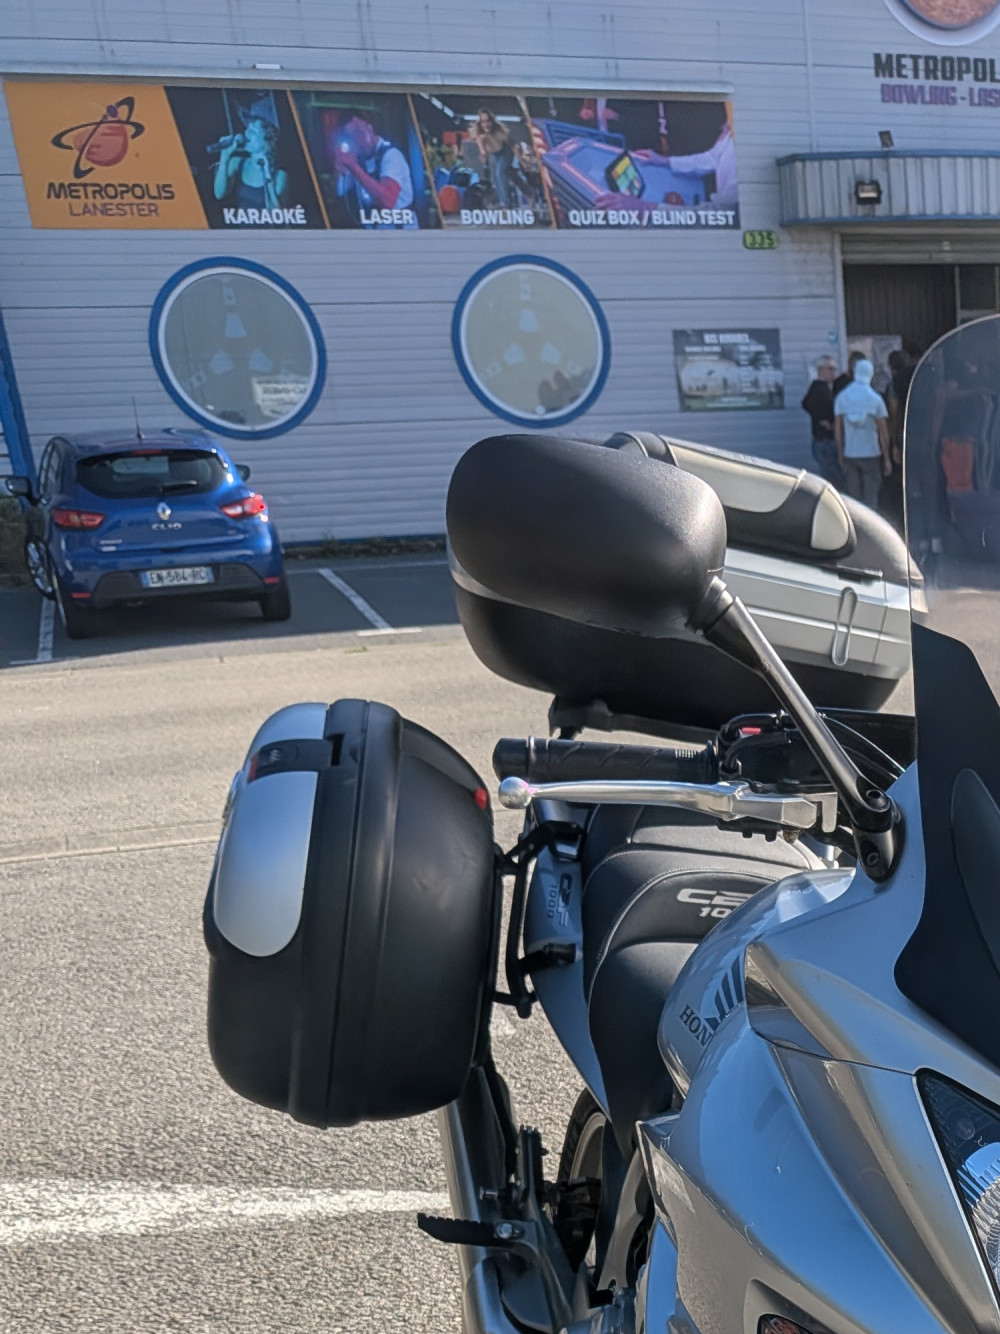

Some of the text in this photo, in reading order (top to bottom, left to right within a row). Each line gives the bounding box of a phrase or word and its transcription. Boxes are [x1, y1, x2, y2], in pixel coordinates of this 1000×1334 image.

[880, 83, 957, 105] BOWLING
[46, 182, 175, 200] METROPOLIS
[68, 202, 160, 217] LANESTER
[223, 204, 307, 225] KARAOKÉ
[360, 208, 415, 225] LASER
[460, 209, 536, 226] BOWLING
[569, 210, 606, 226] QUIZ
[607, 210, 640, 226] BOX
[652, 210, 697, 226] BLIND
[698, 210, 736, 226] TEST
[699, 906, 733, 919] 10
[679, 1004, 713, 1047] HON
